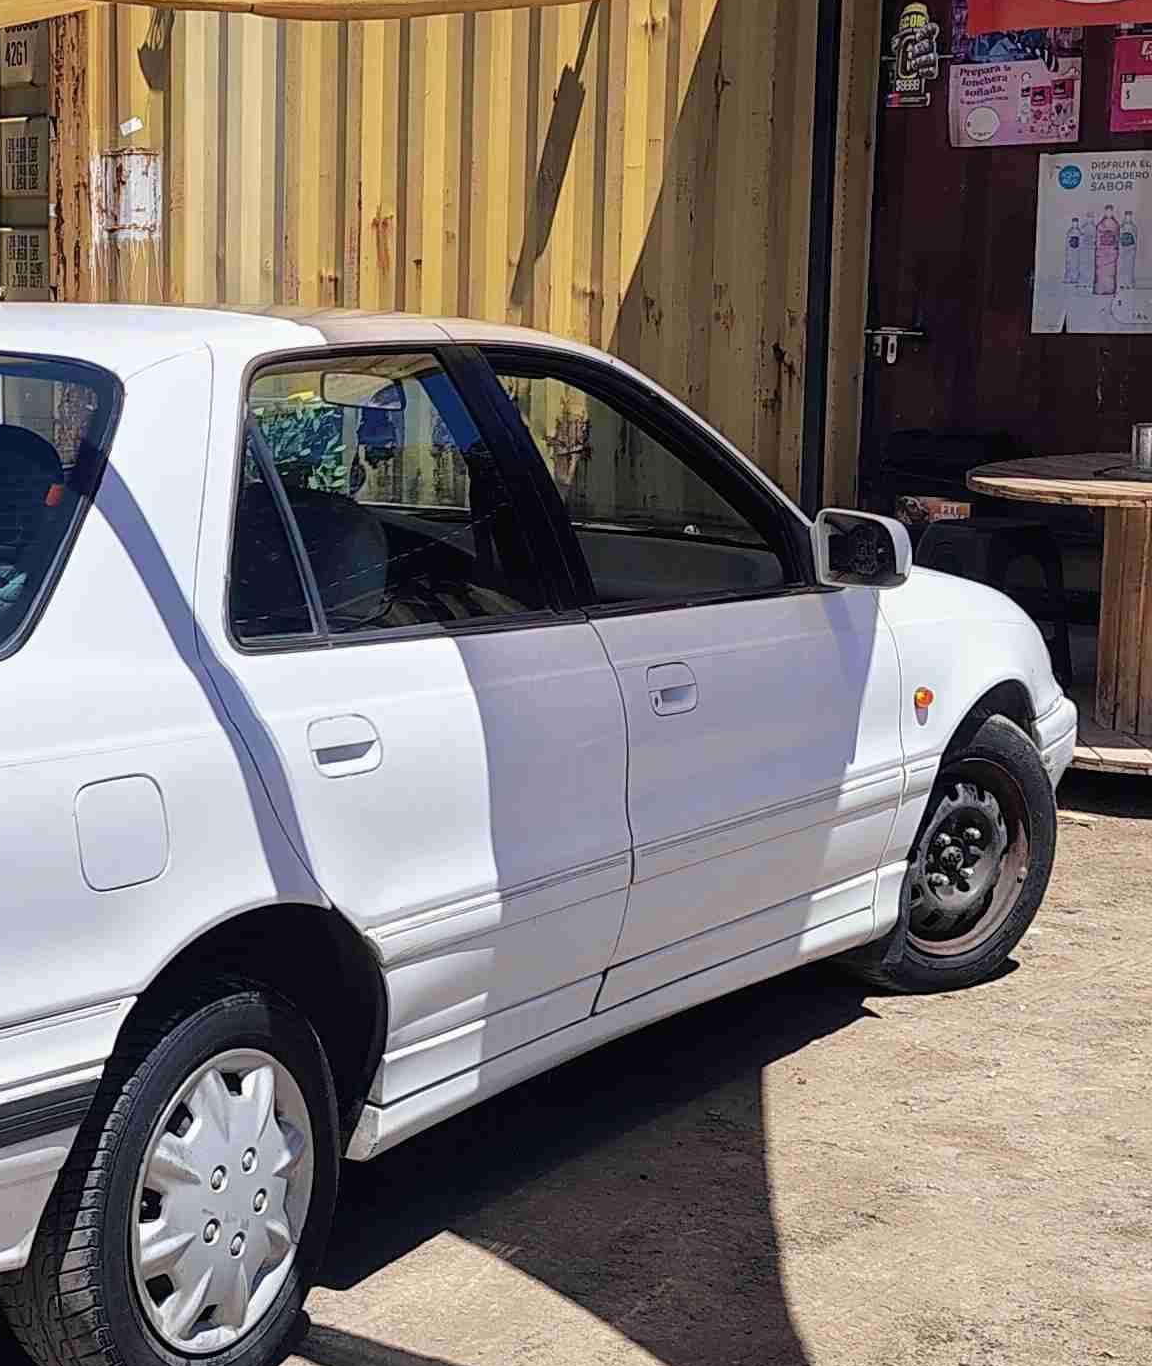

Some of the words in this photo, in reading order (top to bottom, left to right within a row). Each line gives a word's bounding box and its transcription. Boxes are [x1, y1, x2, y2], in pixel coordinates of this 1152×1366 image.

[1091, 160, 1137, 170] DISFRUTA
[1090, 171, 1149, 180] VERDADERO
[1089, 180, 1134, 192] SABOR
